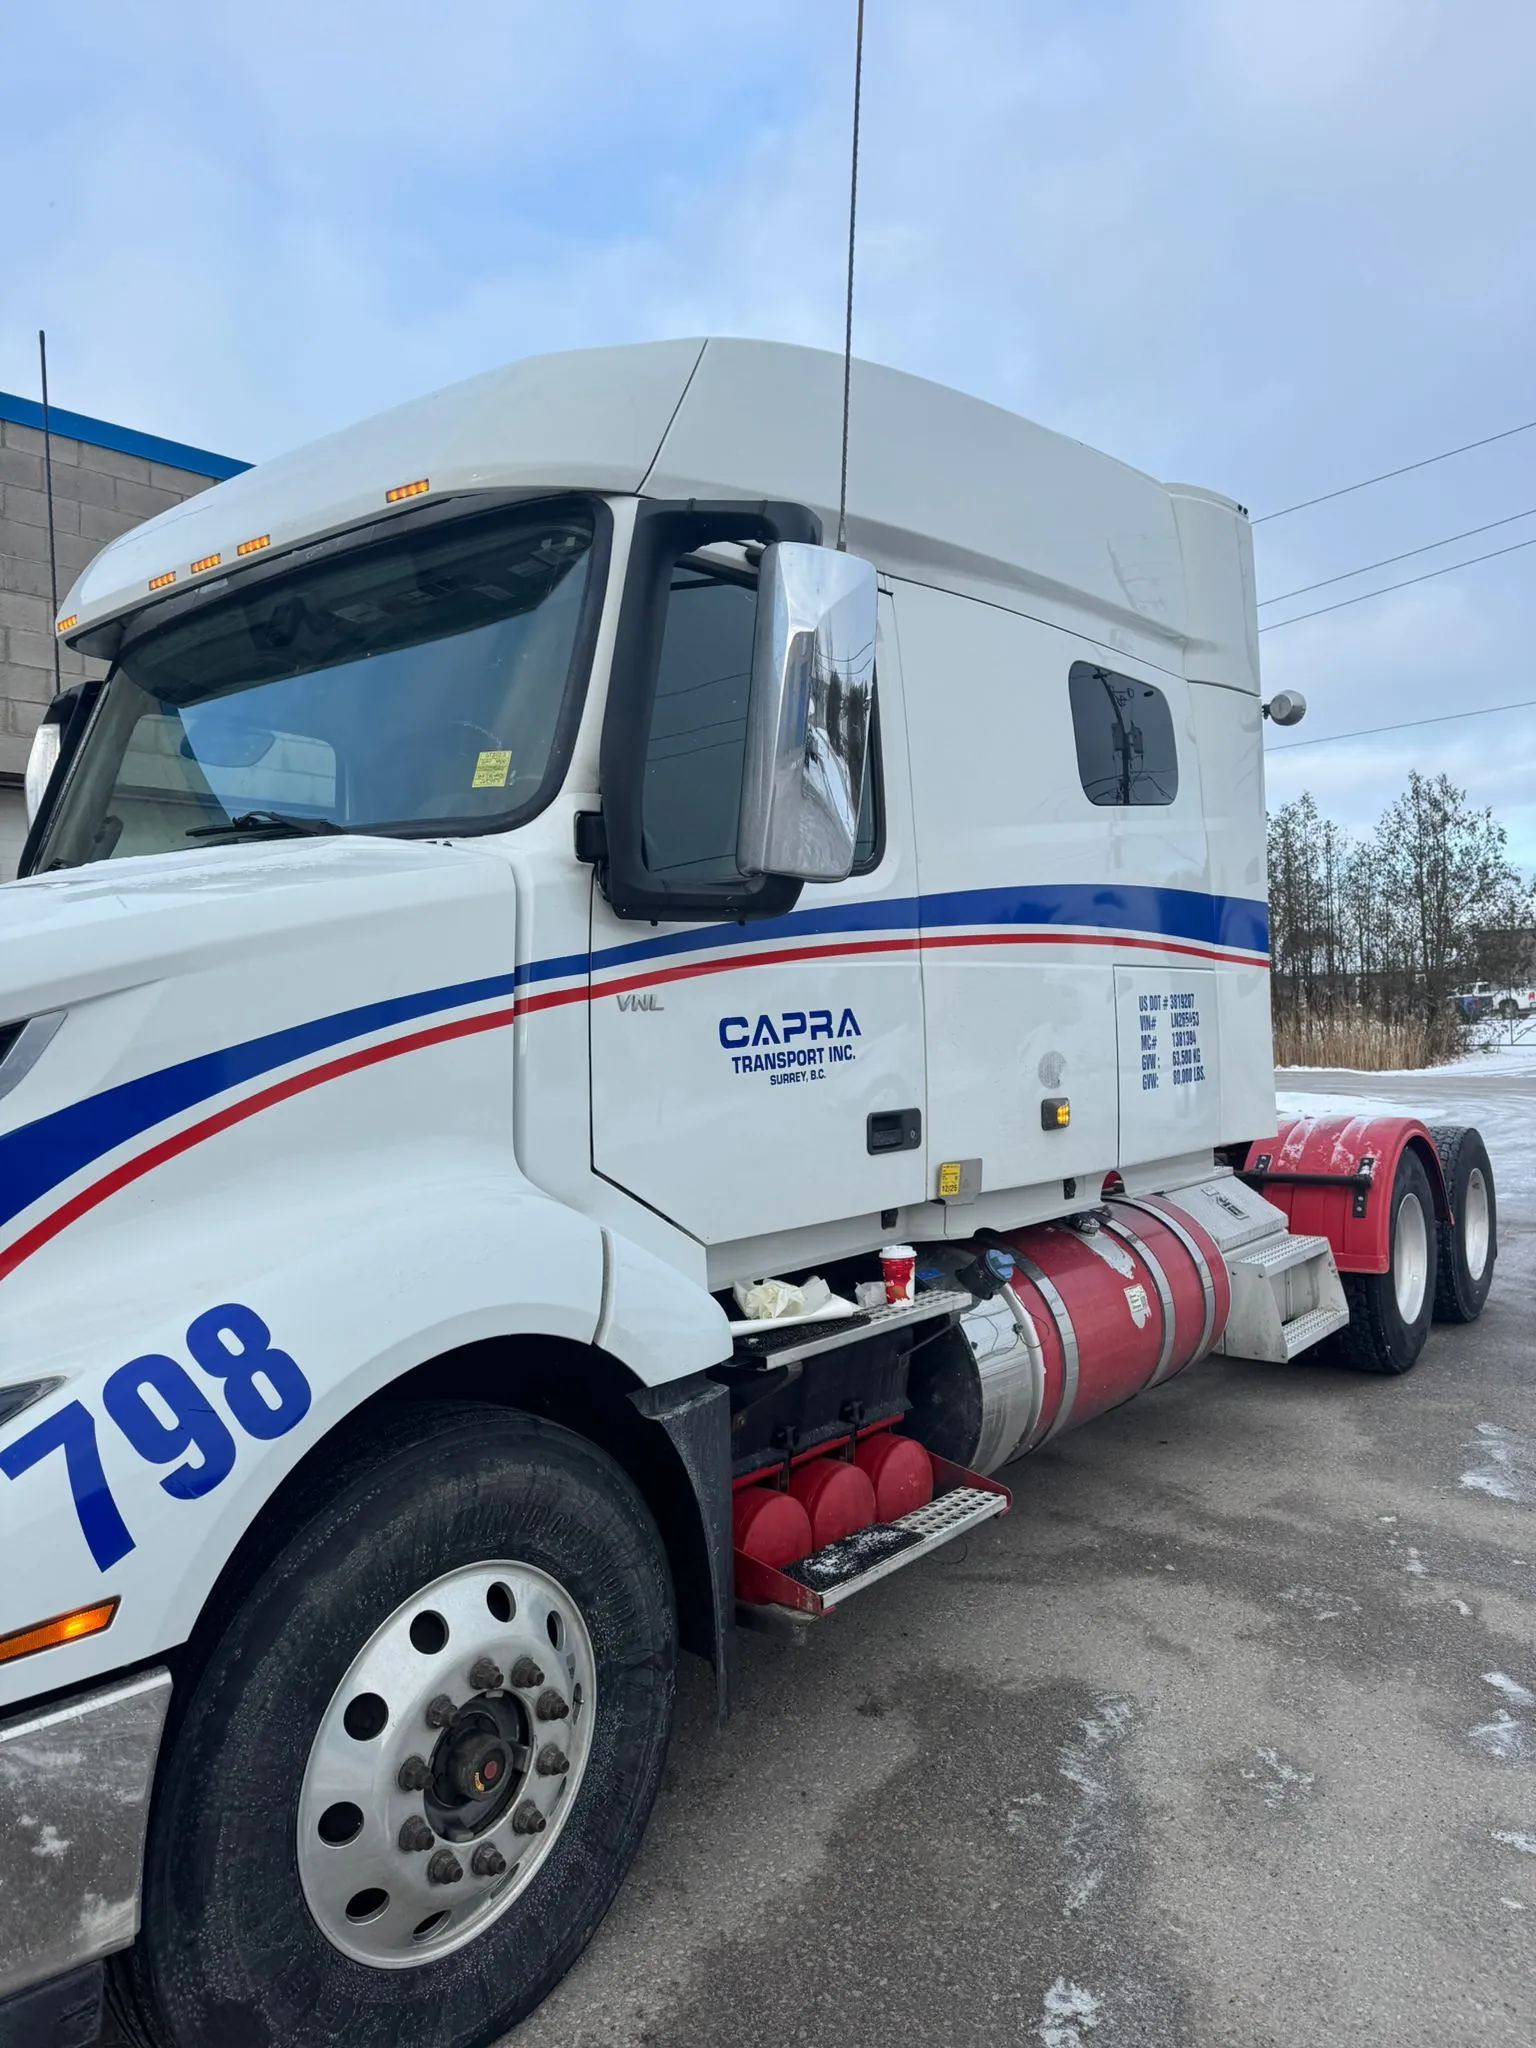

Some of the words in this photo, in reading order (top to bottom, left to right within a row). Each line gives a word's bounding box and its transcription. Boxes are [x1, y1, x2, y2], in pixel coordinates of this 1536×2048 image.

[616, 993, 665, 1013] VNL
[1139, 995, 1148, 1012] US
[1149, 995, 1161, 1011] DOT
[1163, 996, 1168, 1011] #
[719, 1008, 862, 1049] CAPRA
[1140, 1015, 1157, 1032] VIN#
[1141, 1034, 1157, 1051] MC#
[731, 1047, 825, 1075] TRANSPORT
[828, 1044, 856, 1063] INC.
[1193, 1047, 1201, 1064] KG
[770, 1071, 809, 1086] SURREY,
[810, 1068, 827, 1081] B.C.
[1142, 1072, 1159, 1090] GVW:
[0, 1303, 312, 1574] 798
